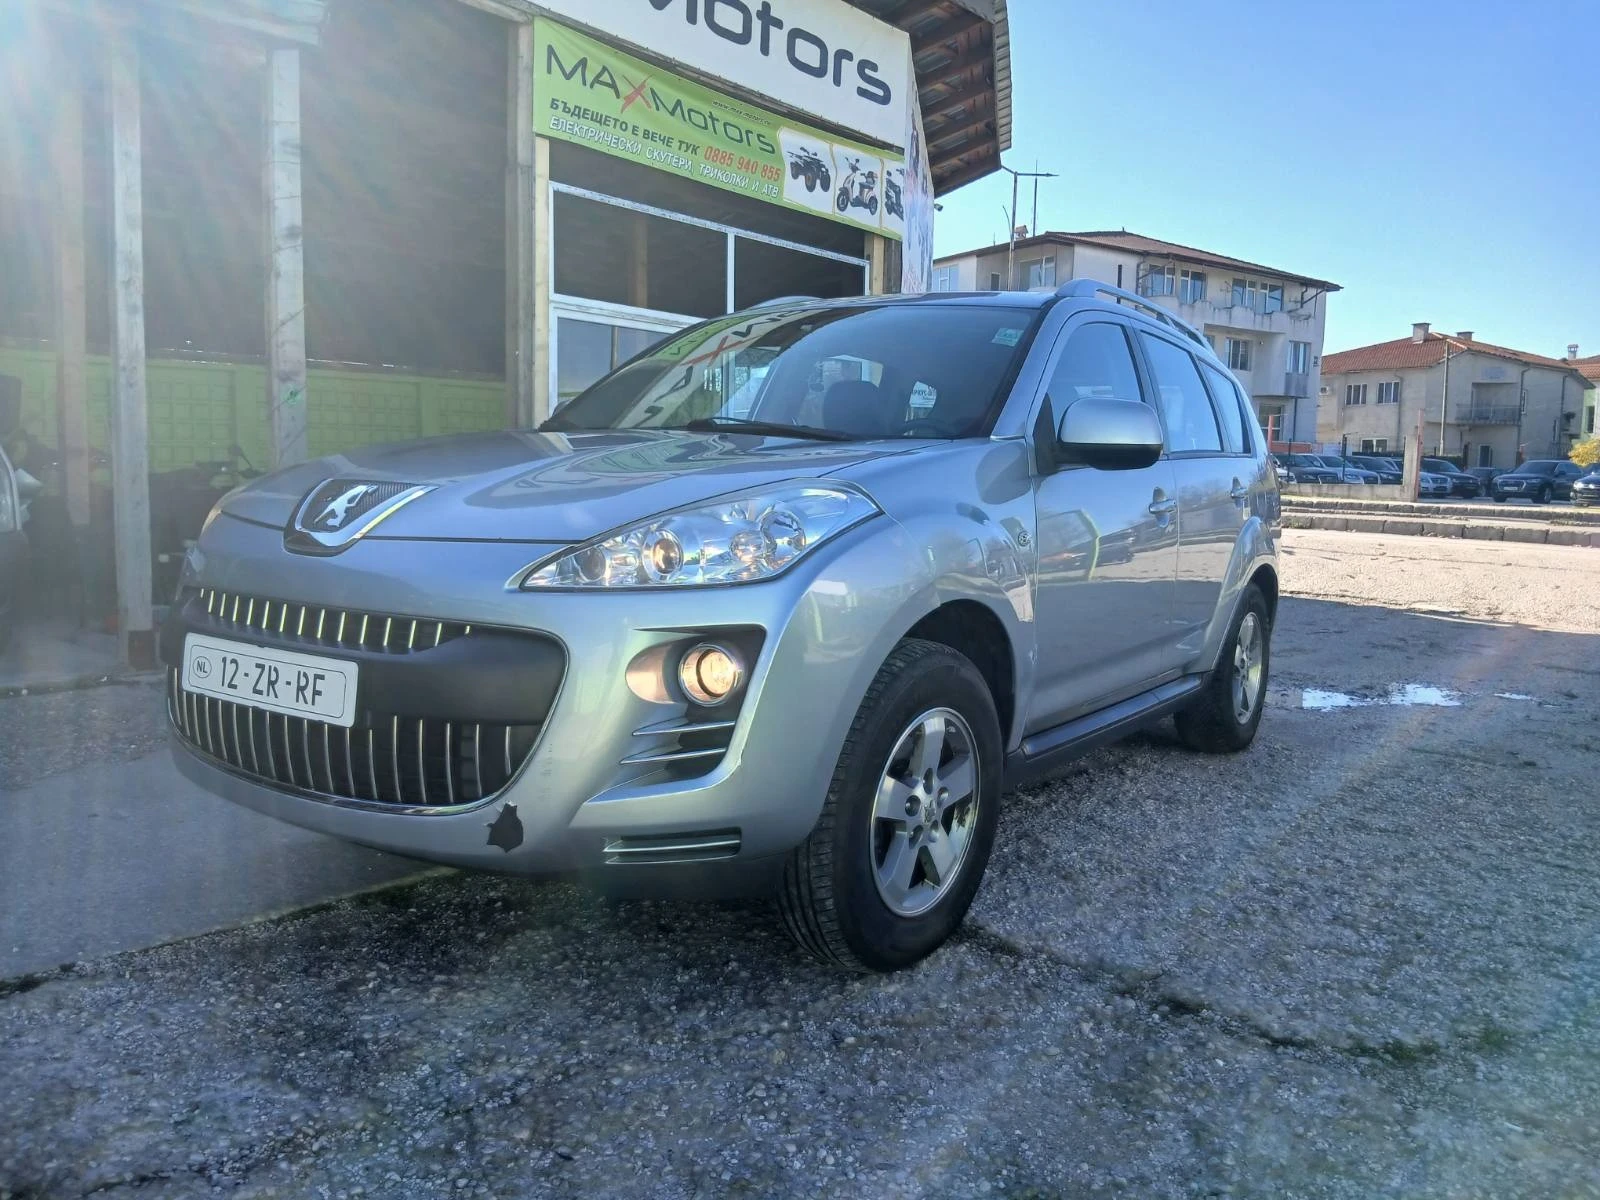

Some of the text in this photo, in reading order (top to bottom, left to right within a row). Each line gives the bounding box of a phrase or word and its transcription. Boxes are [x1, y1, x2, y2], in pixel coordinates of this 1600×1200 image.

[549, 115, 642, 155] ЕЛЕКТРИЧЕСКИ
[699, 163, 750, 189] ТРИКОЛКИ
[751, 181, 761, 192] И
[550, 97, 782, 182] БЪДЕЩЕТО Е ВЕЧЕ ТУК 0885 940 855
[196, 656, 326, 706] NL 12-ZR-RF
